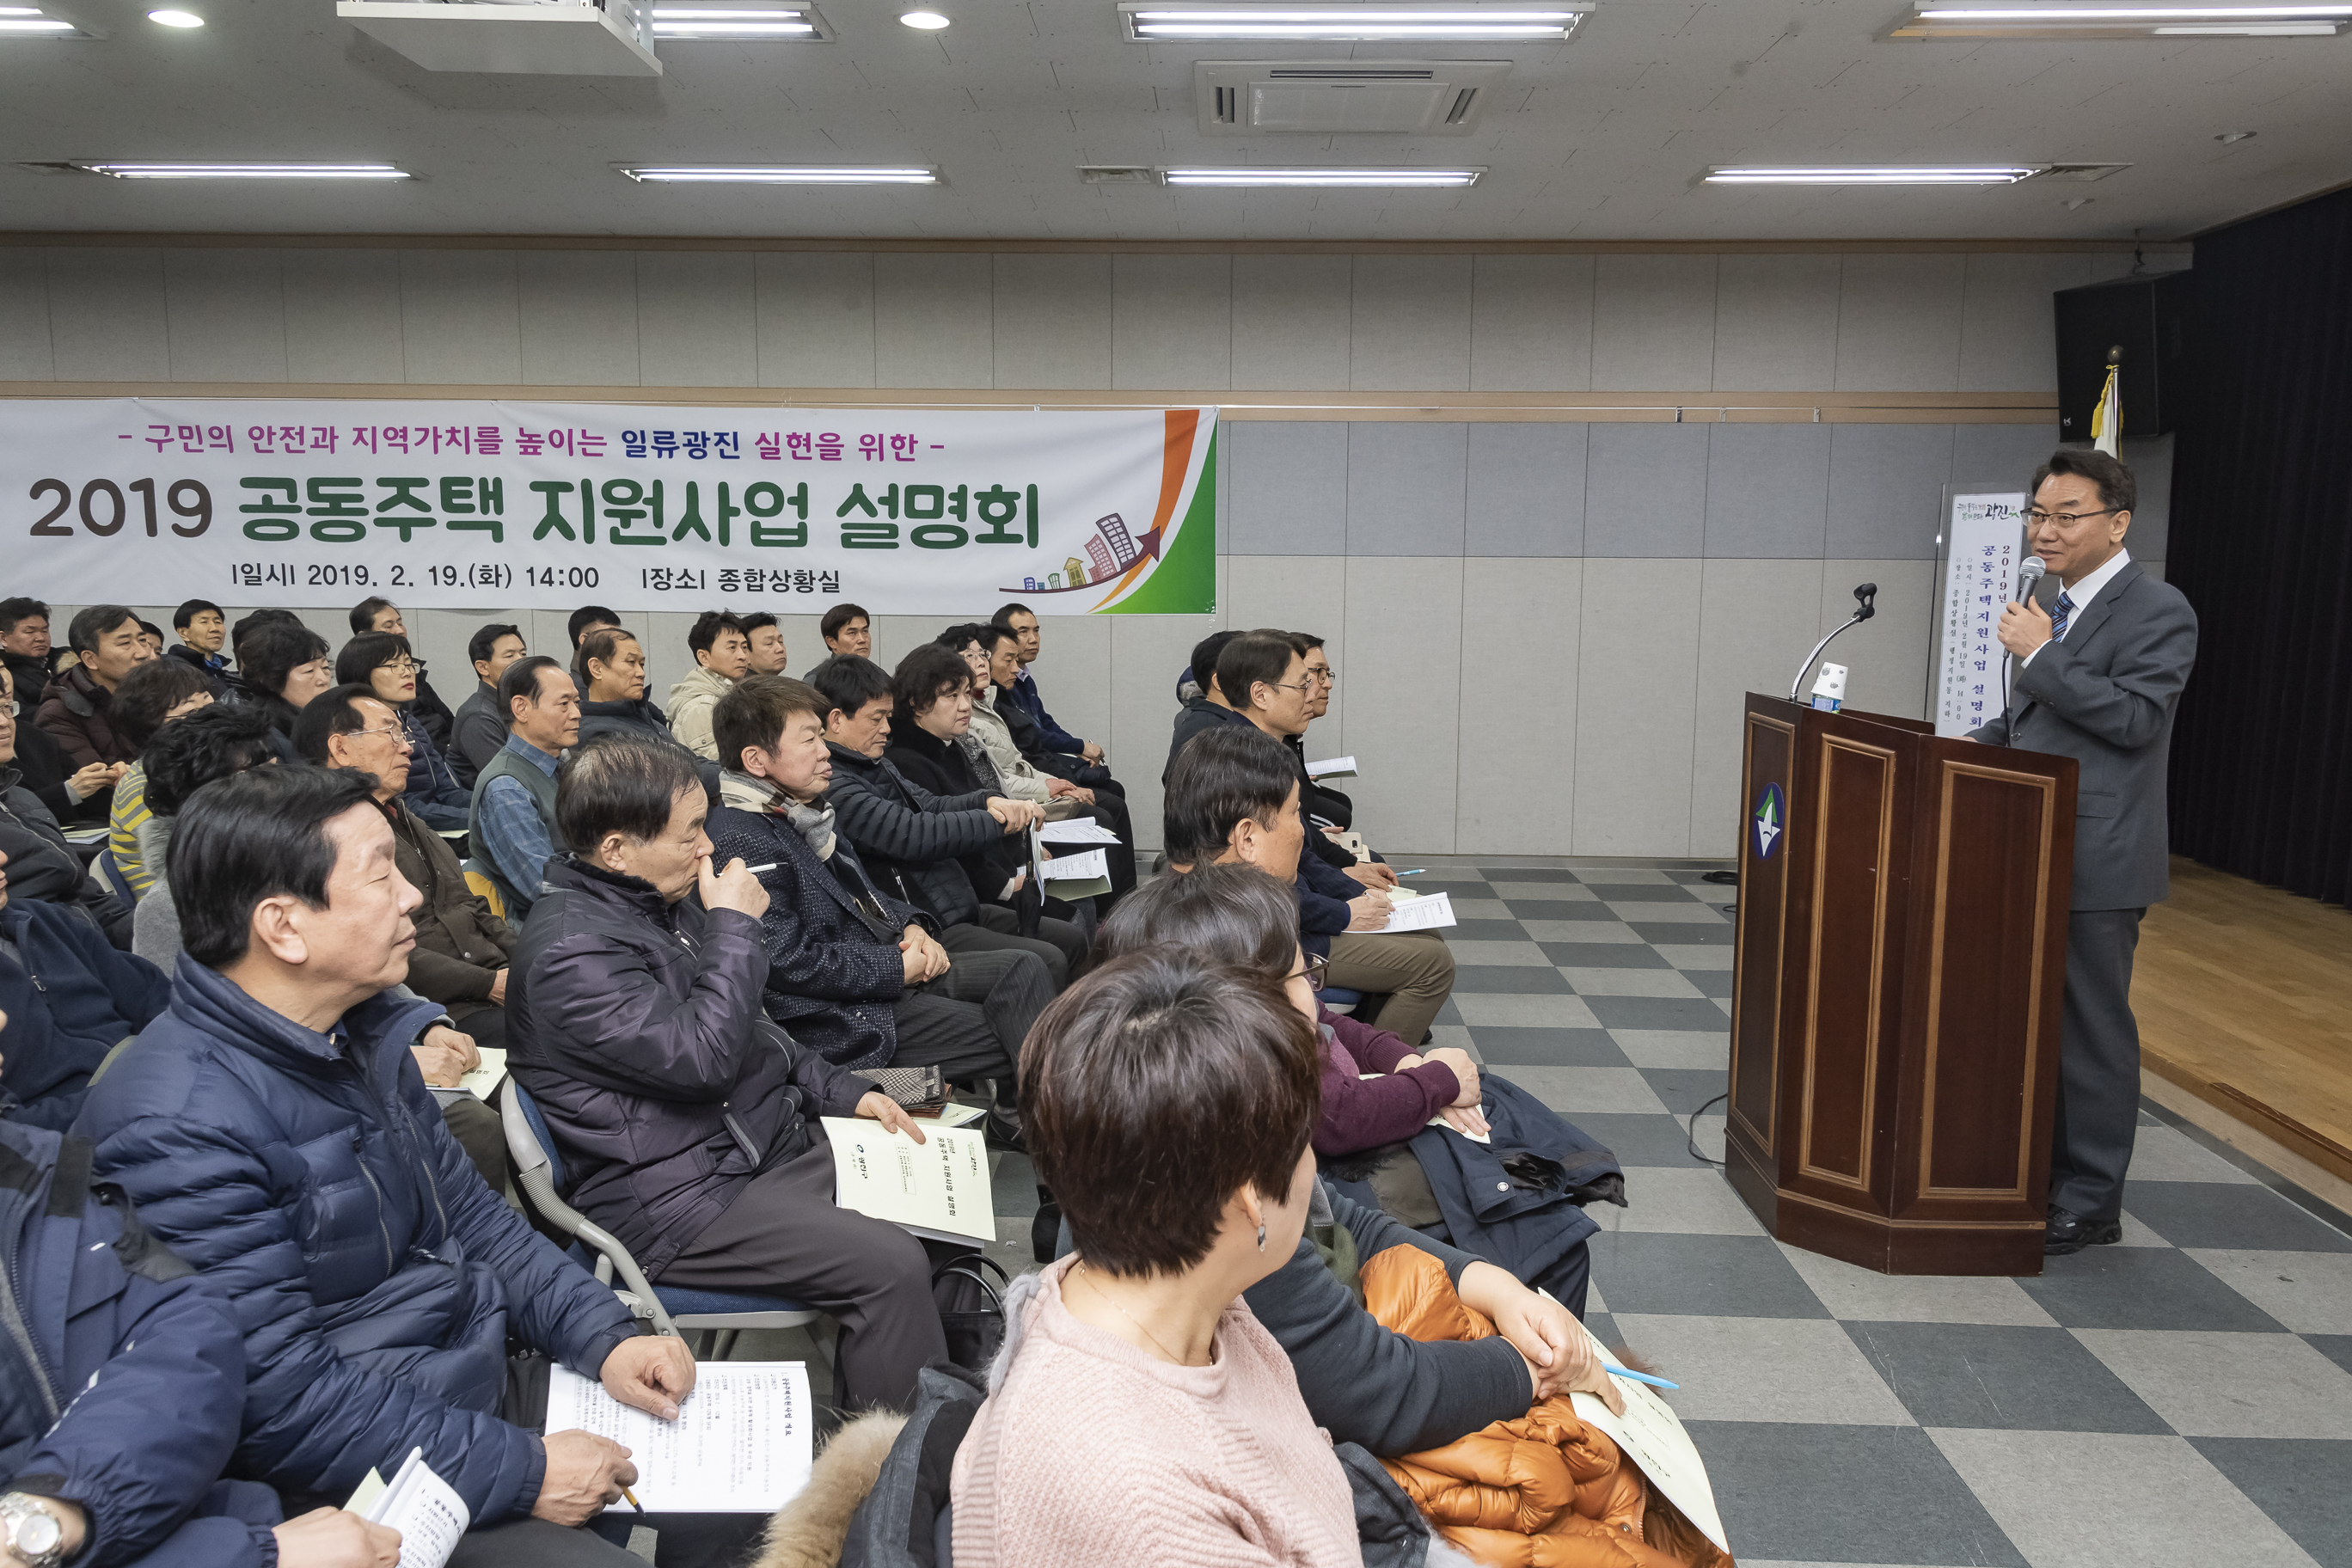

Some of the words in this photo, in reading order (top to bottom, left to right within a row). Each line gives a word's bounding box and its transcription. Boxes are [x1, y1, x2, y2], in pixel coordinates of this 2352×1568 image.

[144, 424, 235, 454] 구민의
[248, 425, 340, 455] 안전과
[352, 426, 504, 456] 지역가치를
[515, 426, 608, 457] 높이는
[621, 429, 741, 460] 일류광진
[754, 432, 845, 462] 실현을
[857, 432, 919, 462] 위한
[28, 477, 213, 538] 2019
[238, 475, 505, 544] 공동주택
[529, 477, 809, 548] 지원사업
[836, 482, 1039, 550] 설명회
[1985, 503, 2009, 520] 광진
[307, 564, 378, 587] 2019.
[390, 564, 414, 587] 2.
[428, 562, 512, 590] 19.(화)
[525, 566, 600, 589] 14:00
[717, 568, 841, 594] 종합상황실
[1999, 546, 2010, 603] 2019년
[1974, 545, 1996, 671] 공동주택지원사업
[1969, 683, 1984, 728] 설명회
